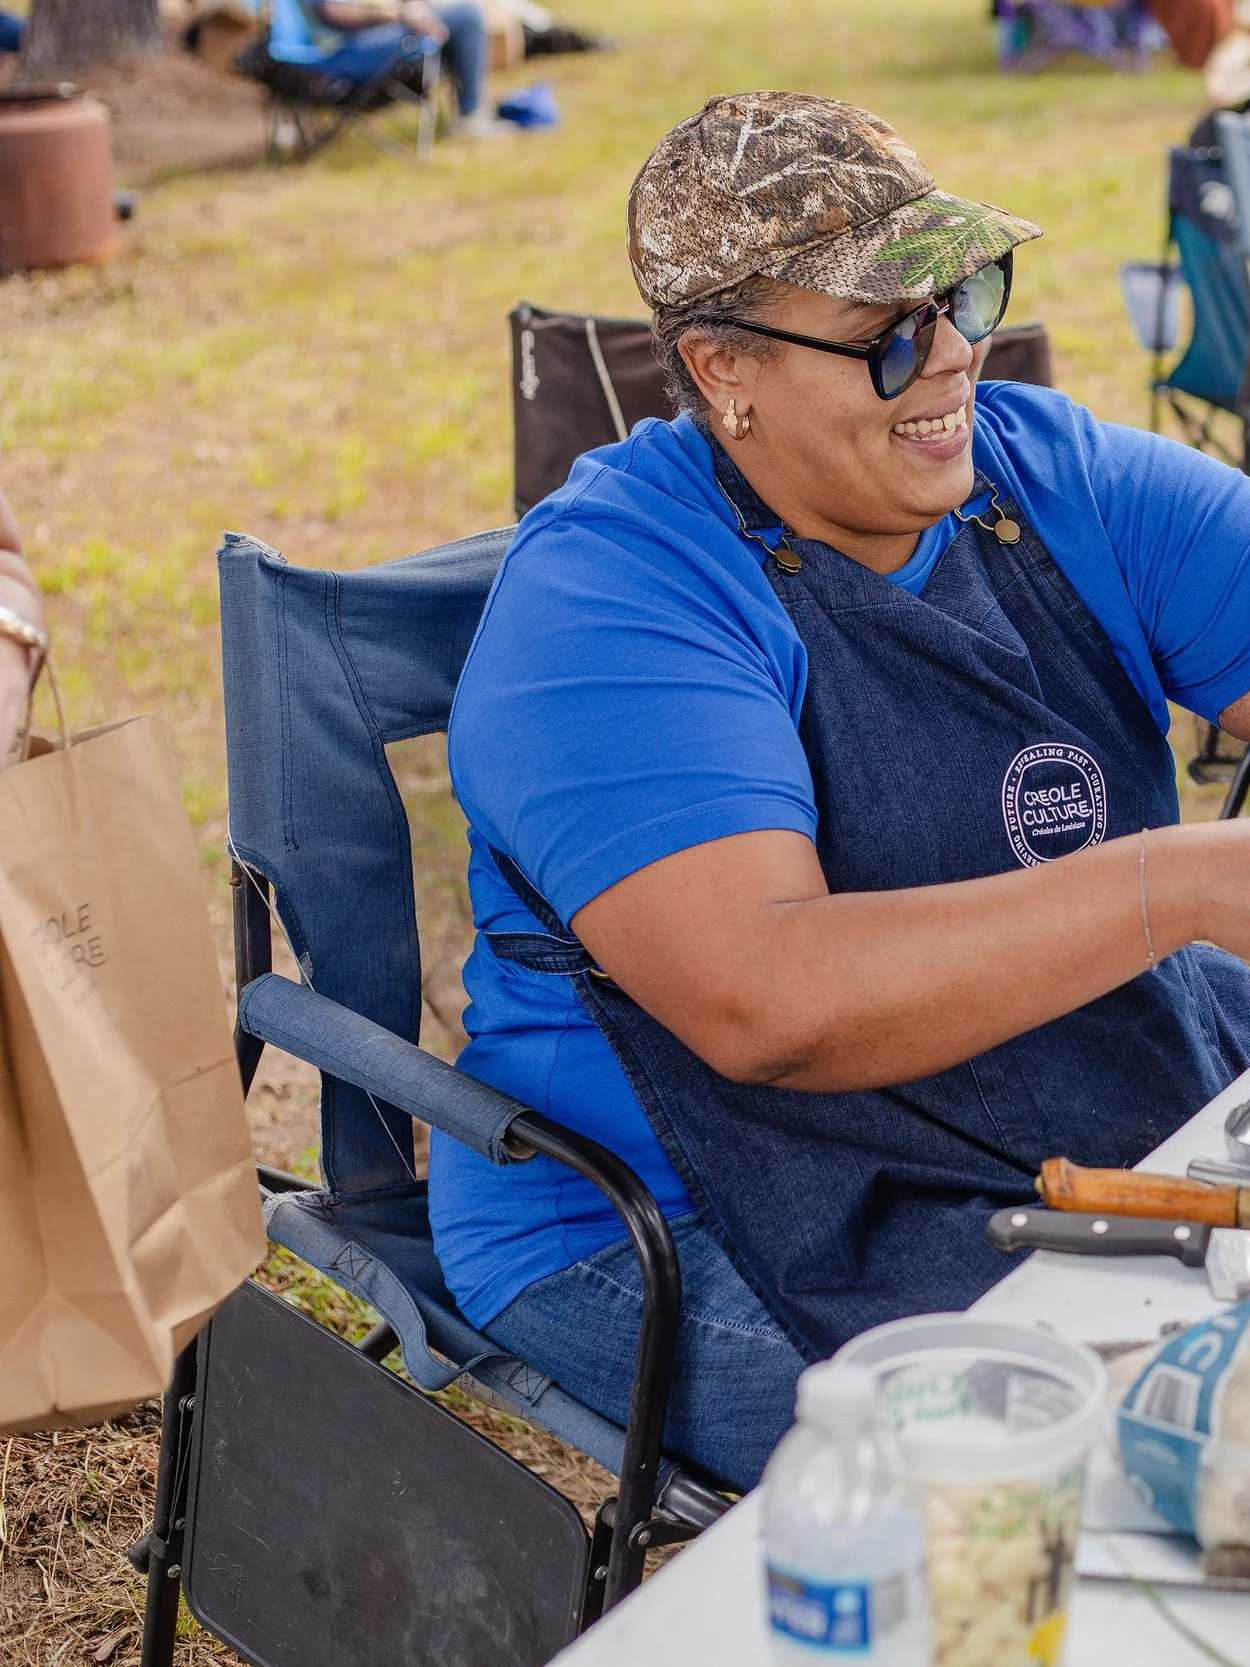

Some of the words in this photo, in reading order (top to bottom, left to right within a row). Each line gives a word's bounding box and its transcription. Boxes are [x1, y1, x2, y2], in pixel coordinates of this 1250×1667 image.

[1015, 748, 1064, 774] REVEALING
[1067, 750, 1089, 767] PAST
[1024, 782, 1082, 806] CREOLE
[1090, 773, 1103, 829] CURATING
[1006, 785, 1019, 832] FUTURE
[1023, 799, 1093, 826] CULTURE
